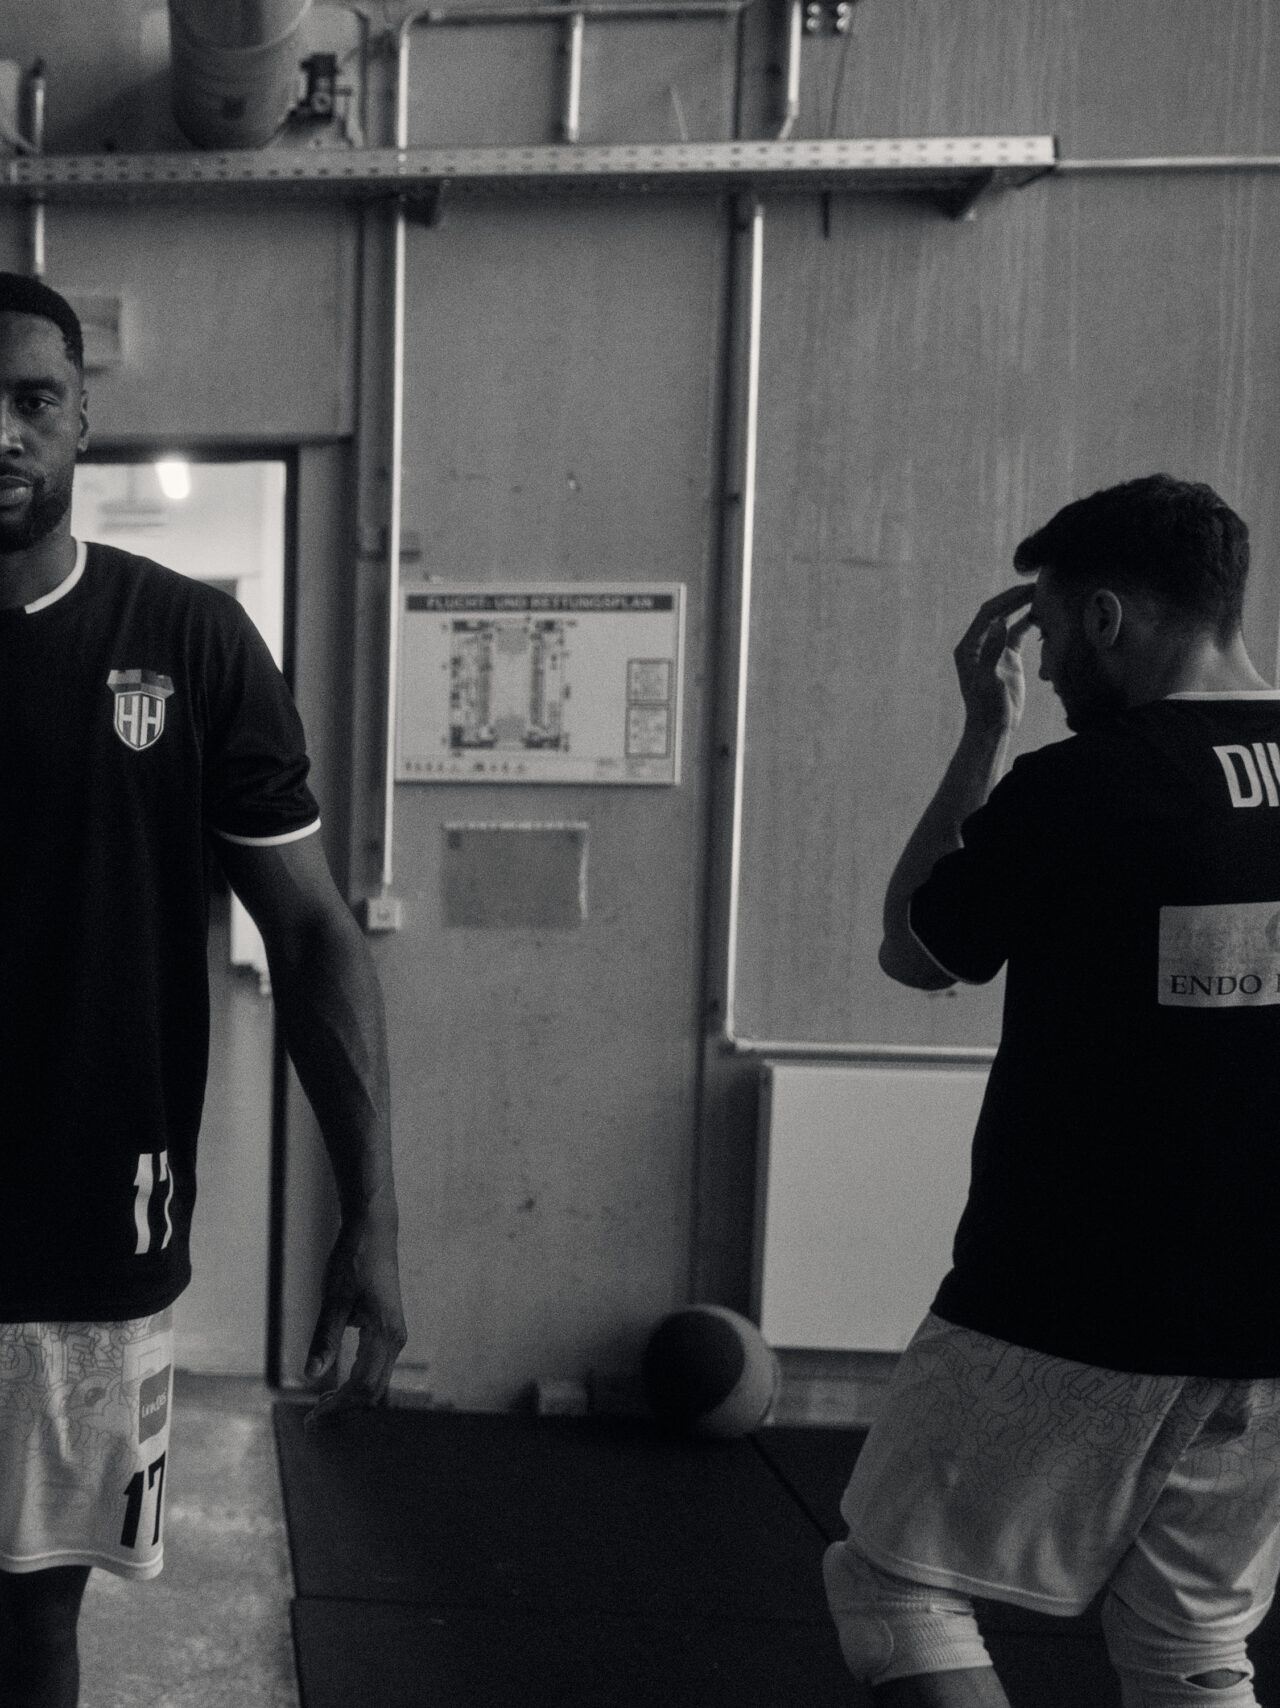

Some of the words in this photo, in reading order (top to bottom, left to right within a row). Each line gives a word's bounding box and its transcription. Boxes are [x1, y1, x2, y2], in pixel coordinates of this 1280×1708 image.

[1171, 974, 1262, 995] ENDO
[133, 1149, 174, 1254] 17
[121, 1450, 166, 1548] 17
